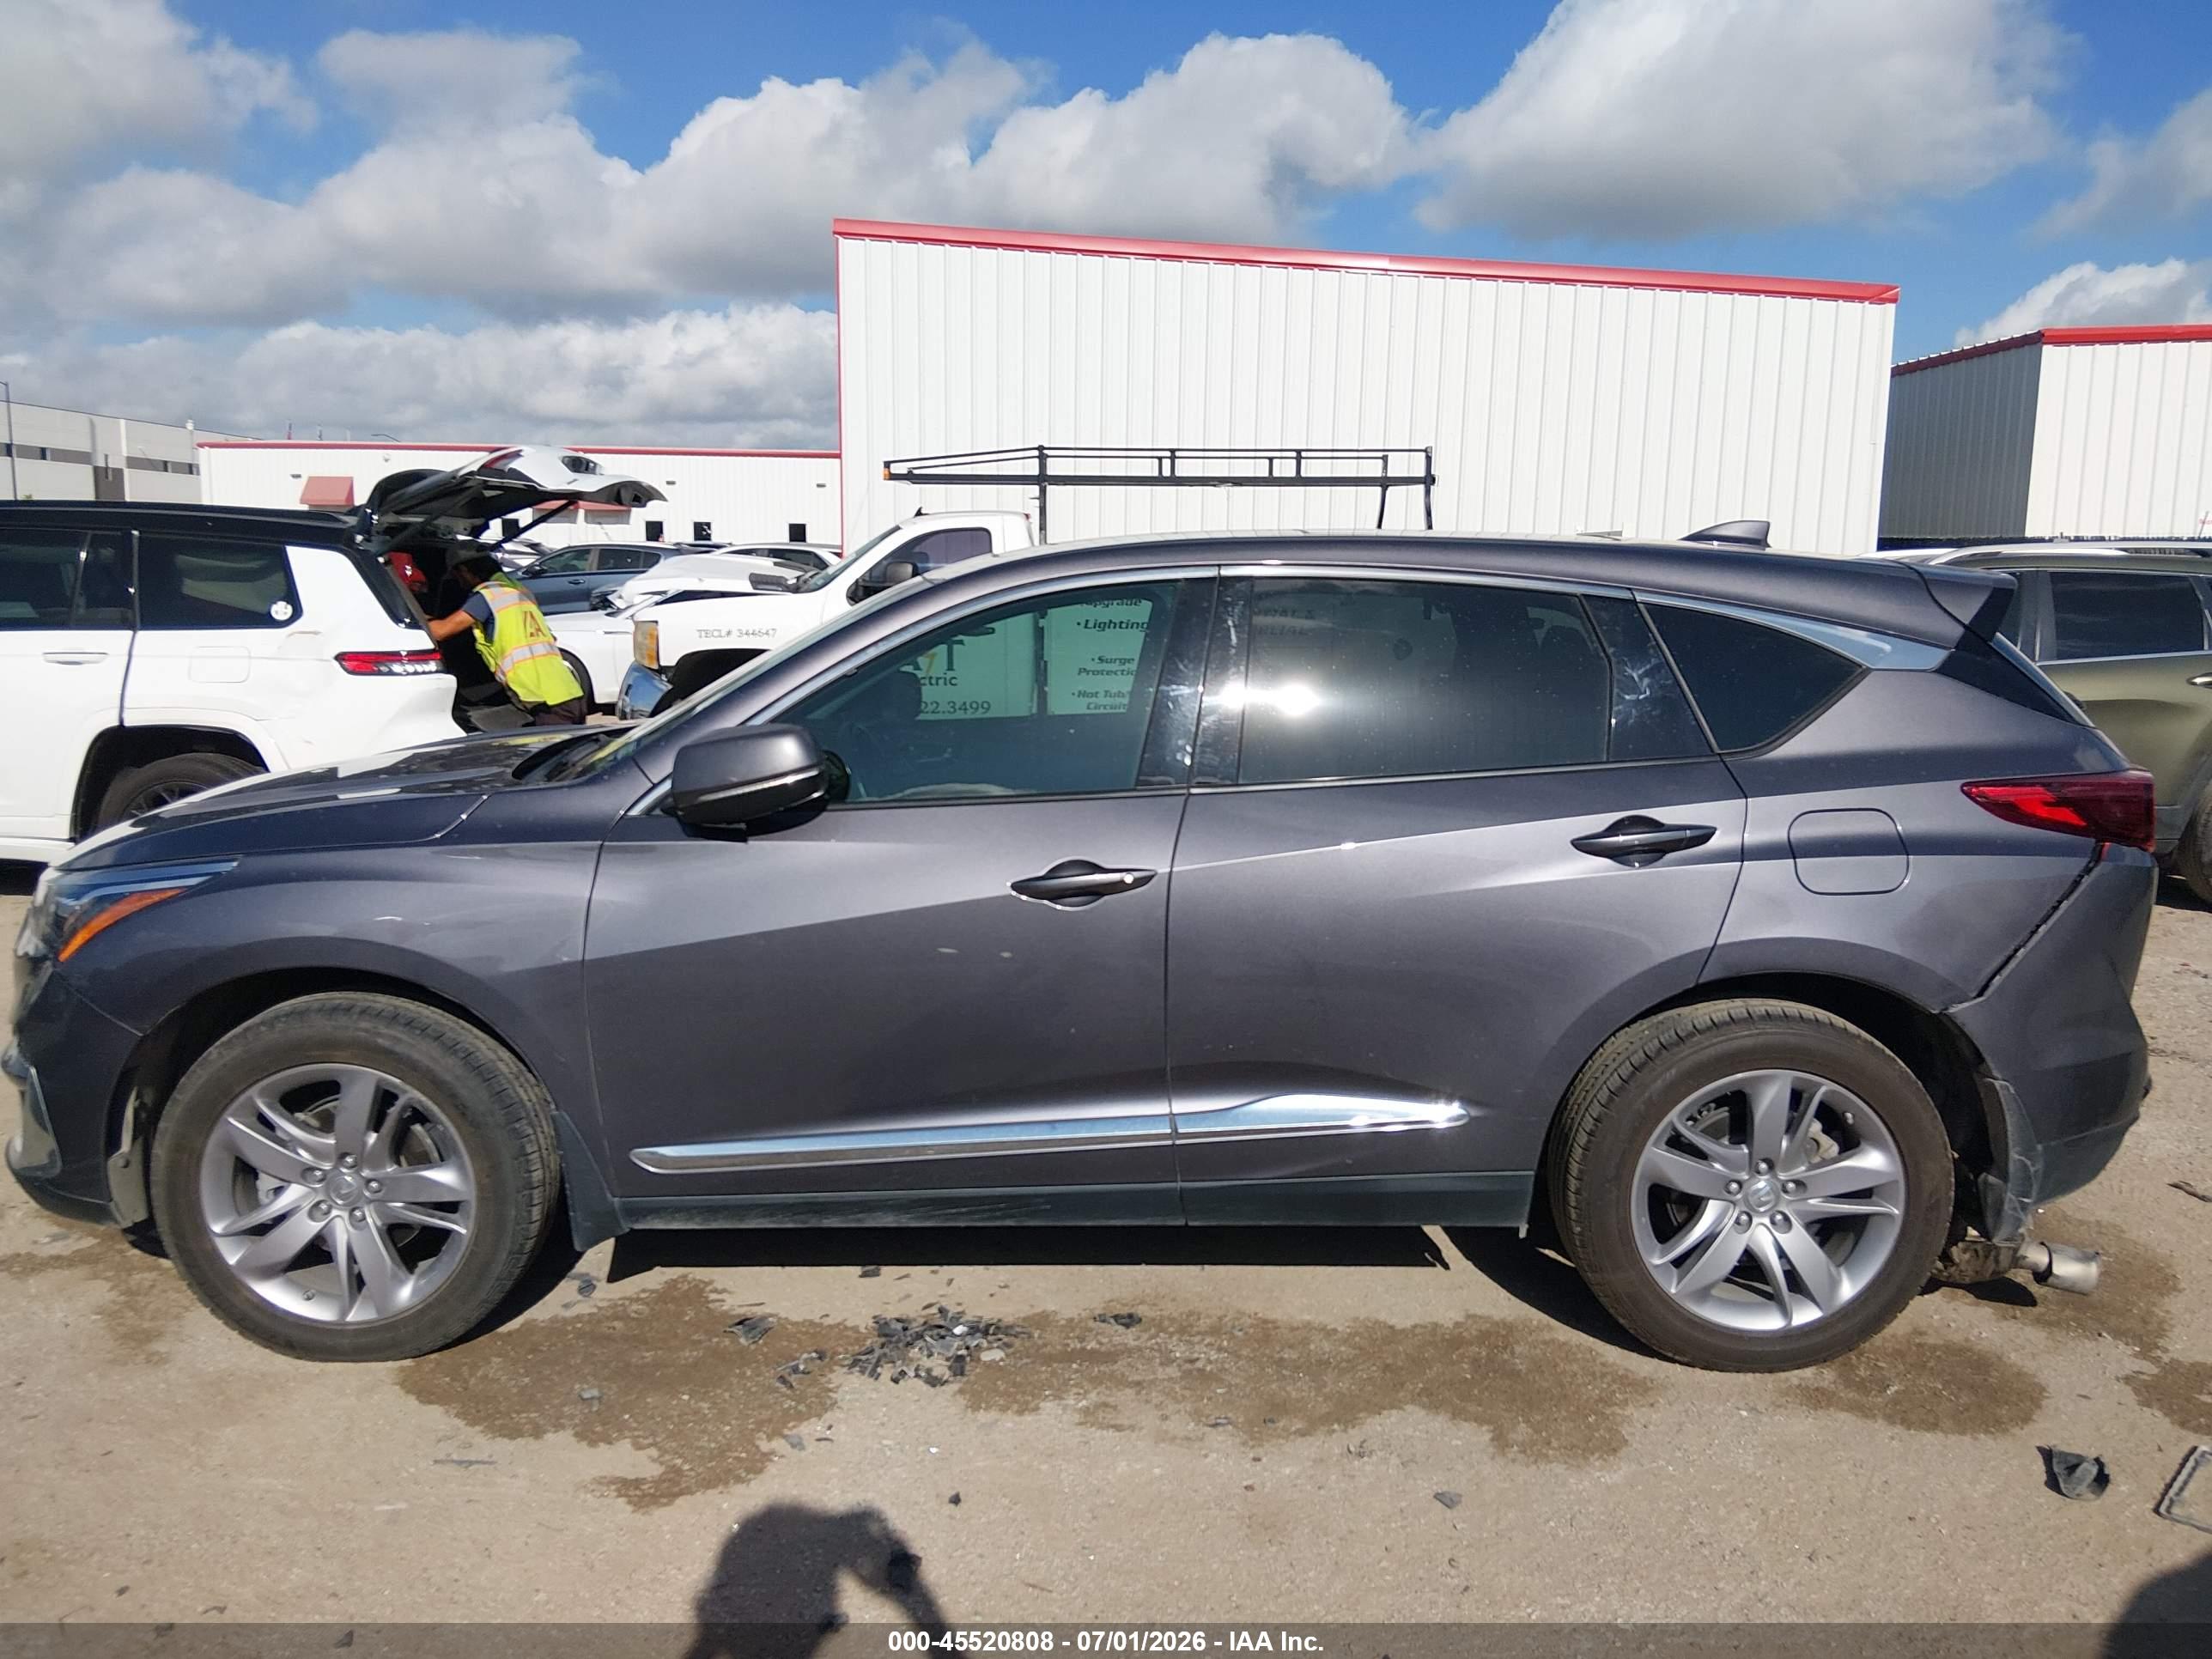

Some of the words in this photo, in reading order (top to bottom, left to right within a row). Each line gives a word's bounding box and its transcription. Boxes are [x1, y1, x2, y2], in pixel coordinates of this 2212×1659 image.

[1086, 599, 1142, 609] pgrade
[1084, 619, 1151, 632] Lighting
[1097, 655, 1135, 666] Surge
[921, 672, 958, 687] ctric
[920, 700, 993, 714] 22.3499
